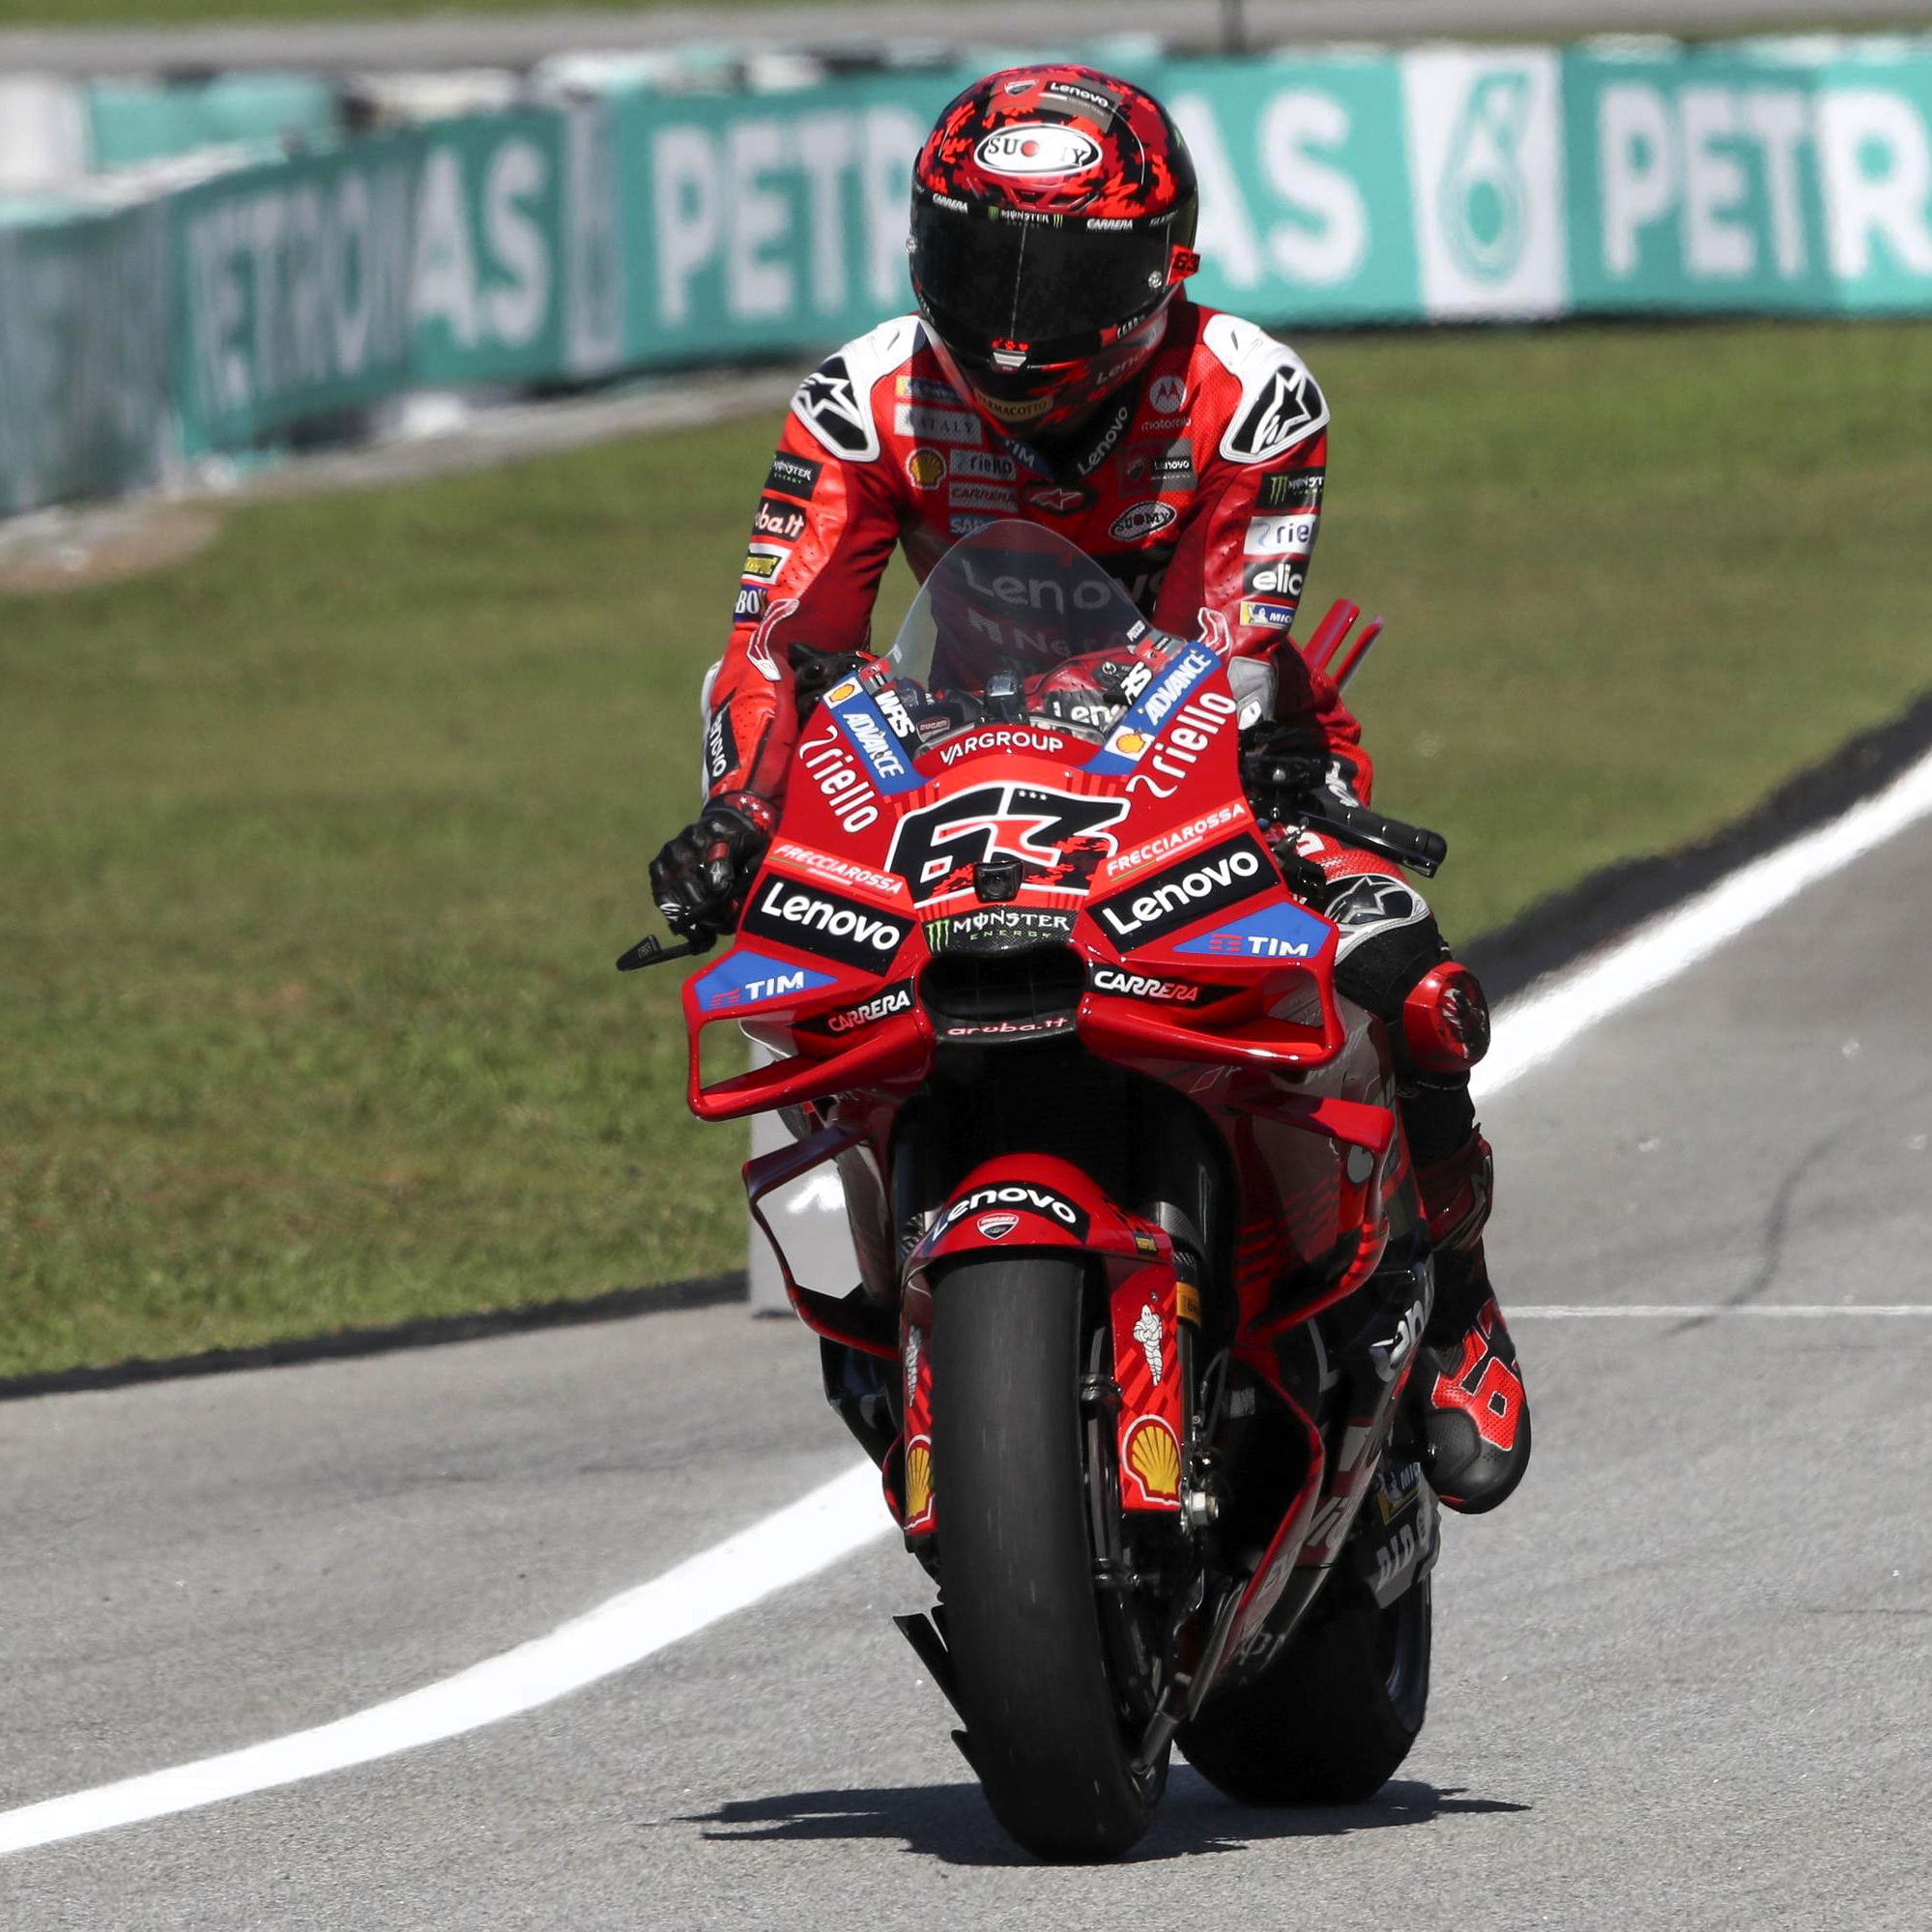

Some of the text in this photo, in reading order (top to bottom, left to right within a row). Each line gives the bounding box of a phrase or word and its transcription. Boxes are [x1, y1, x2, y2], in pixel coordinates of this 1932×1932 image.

[1050, 81, 1109, 107] Lenovo
[1085, 218, 1134, 231] CARRERA
[1077, 406, 1128, 475] Lenovo
[1113, 507, 1171, 534] SUOMY
[875, 689, 916, 738] WRS
[1144, 652, 1212, 726] ADVANCE
[843, 712, 905, 779] ADVANCE
[939, 731, 1064, 764] VARGROUP
[1152, 692, 1237, 780] riello
[806, 748, 879, 833] riello
[883, 781, 1132, 908] 63
[1106, 803, 1246, 877] FRECCIAROSSA
[774, 844, 905, 895] FRECCIAROSSA
[1102, 851, 1259, 936] Lenovo
[761, 881, 901, 951] Lenovo
[969, 930, 1053, 941] ENERGY
[1248, 936, 1310, 957] TIM
[745, 971, 805, 1000] TIM
[1094, 970, 1198, 1002] CARRERA
[828, 990, 911, 1032] CARRERA
[947, 1017, 1068, 1036] aruba.it
[932, 1187, 1077, 1242] Lenovo
